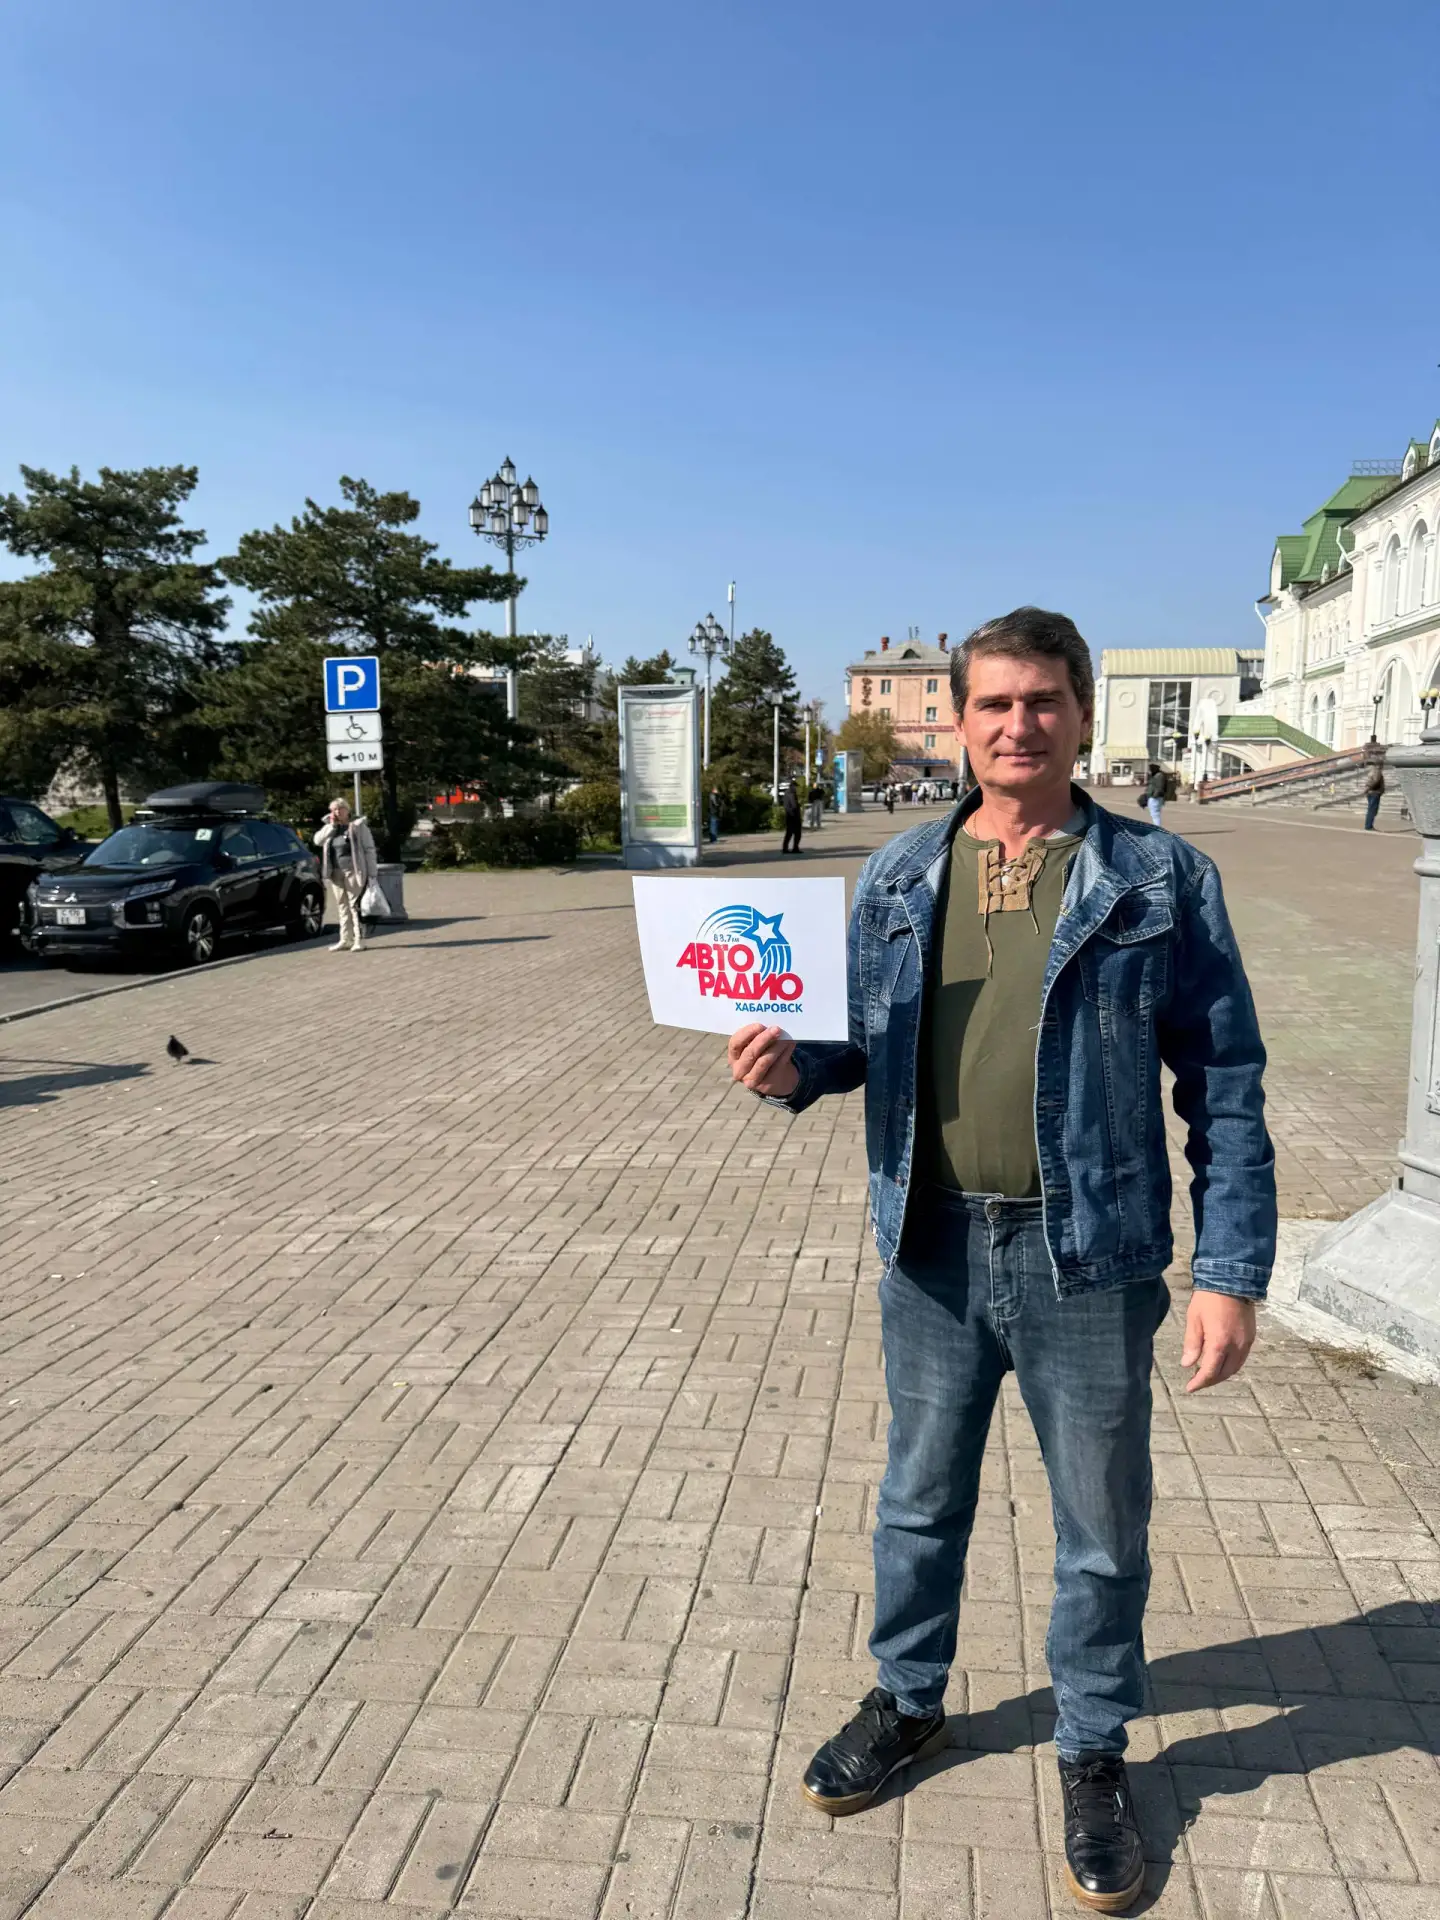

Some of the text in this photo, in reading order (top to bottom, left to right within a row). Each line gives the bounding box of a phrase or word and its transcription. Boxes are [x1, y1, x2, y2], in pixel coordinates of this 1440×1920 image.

[337, 665, 366, 706] P
[351, 752, 365, 762] 10
[676, 942, 755, 972] АВТО
[697, 970, 804, 1001] РАДИО
[735, 1002, 803, 1013] ХАБАРОВСК
